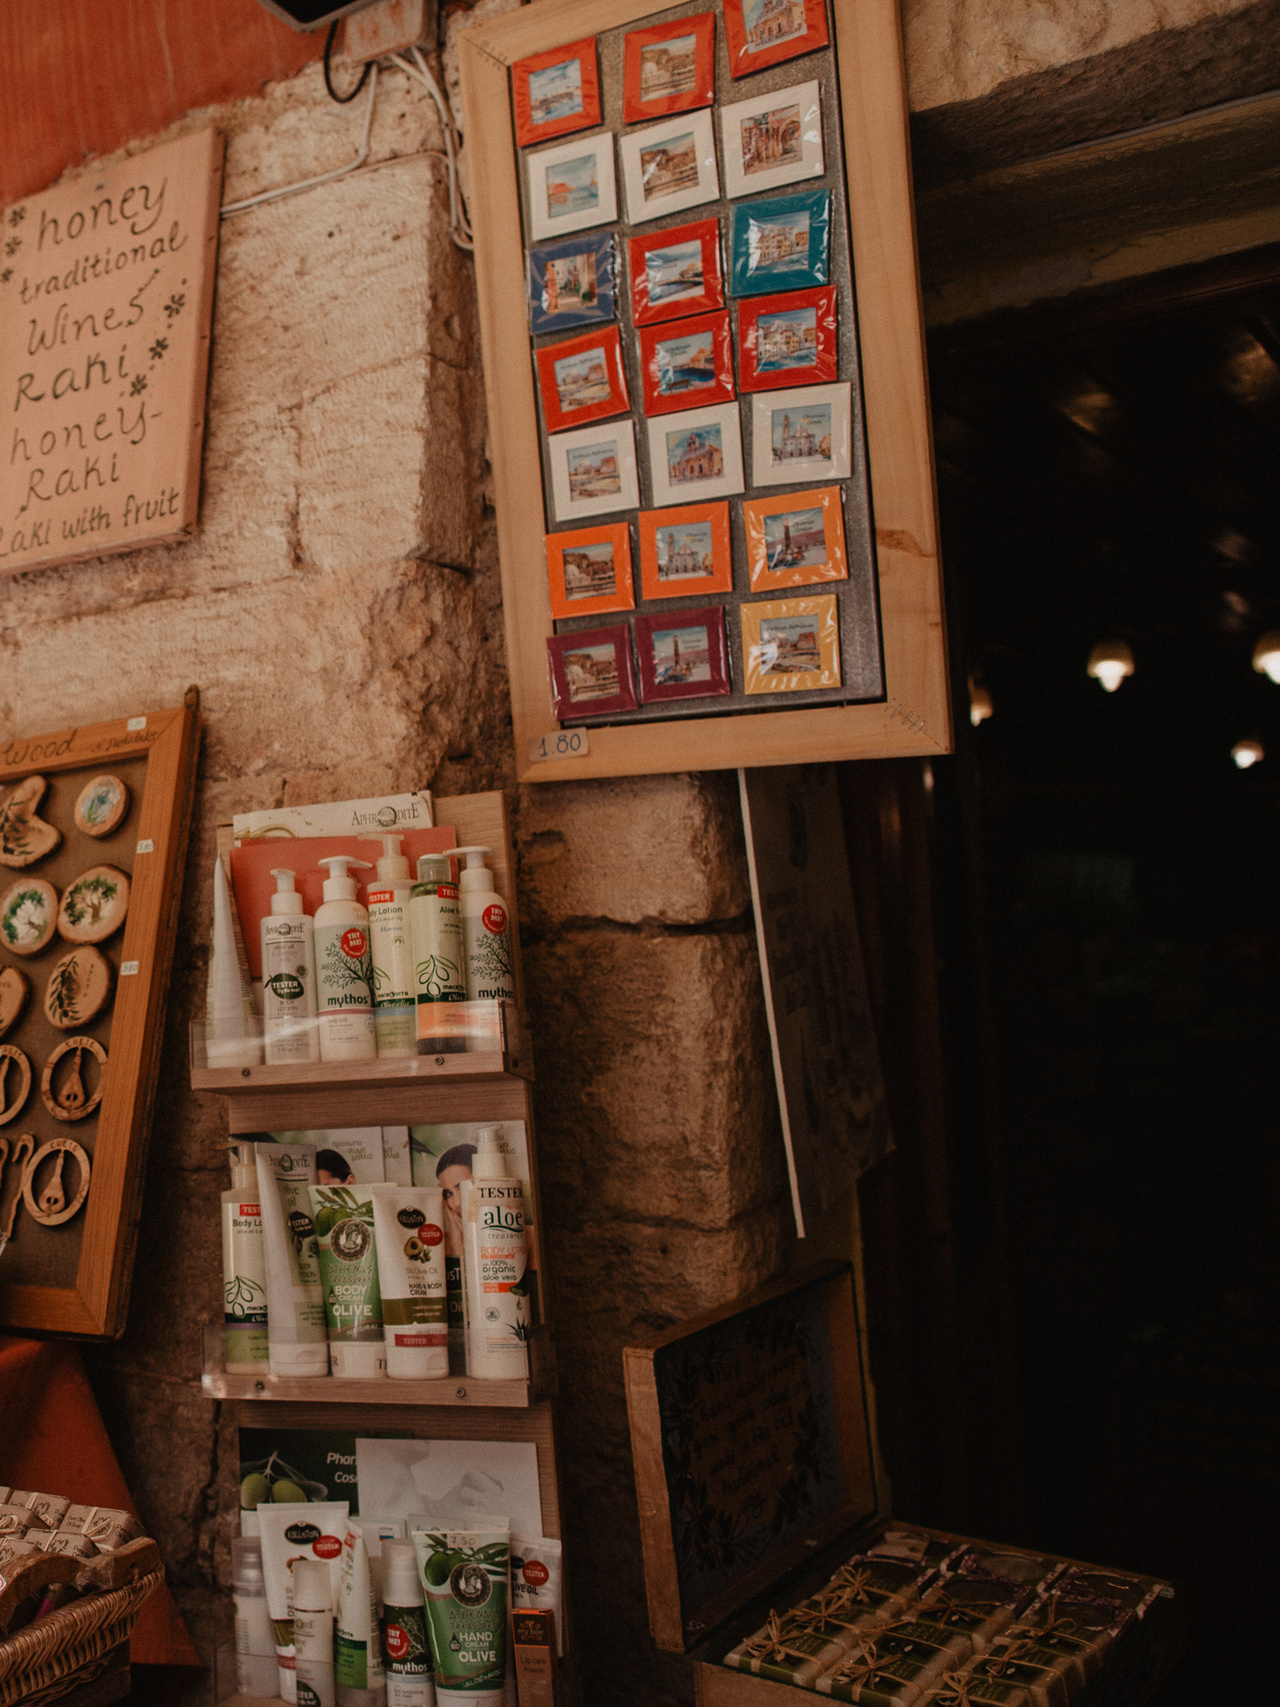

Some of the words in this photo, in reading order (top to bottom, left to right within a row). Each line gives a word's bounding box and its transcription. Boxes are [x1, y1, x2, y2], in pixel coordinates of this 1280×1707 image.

[37, 175, 168, 251] honey
[20, 220, 189, 304] traditional
[62, 505, 112, 540] with
[122, 486, 180, 528] fruit
[3, 728, 78, 767] Wood
[351, 803, 420, 827] APHRODITE
[378, 906, 403, 915] Lotion
[439, 906, 455, 914] Aloe
[491, 908, 502, 916] TRY
[347, 932, 360, 940] TRY
[349, 939, 362, 947] ME!
[272, 980, 299, 989] TESTER
[327, 994, 369, 1008] mythos
[484, 1205, 523, 1226] aloe
[233, 1219, 251, 1228] Body
[480, 1246, 504, 1255] BODY
[482, 1264, 516, 1275] organic
[335, 1285, 367, 1295] BODY
[333, 1304, 373, 1316] OLIVE
[315, 1543, 340, 1551] TESTER
[525, 1570, 545, 1578] TESTER
[387, 1629, 400, 1638] TRY
[459, 1632, 493, 1642] HAND
[458, 1650, 497, 1663] OLIVE
[392, 1662, 428, 1675] mythos
